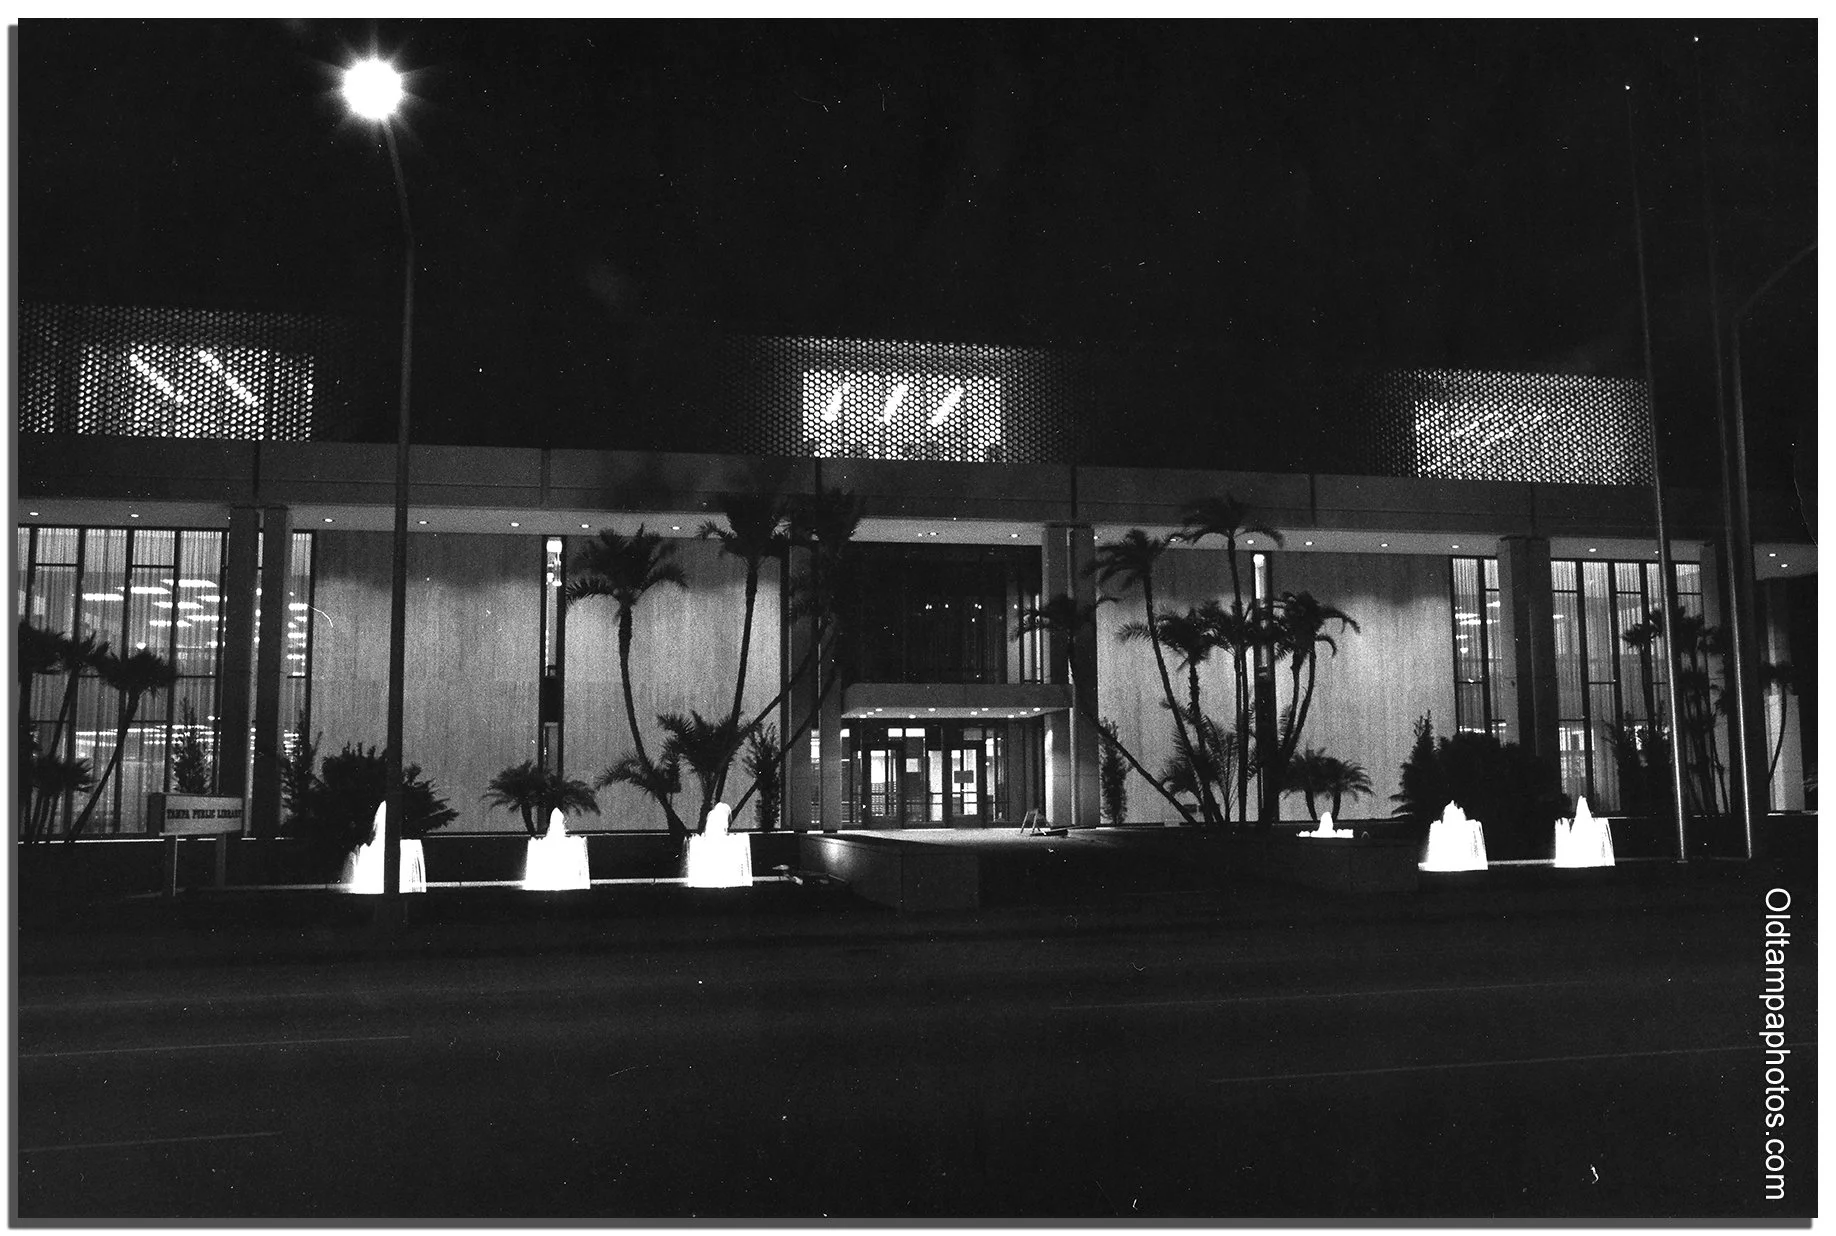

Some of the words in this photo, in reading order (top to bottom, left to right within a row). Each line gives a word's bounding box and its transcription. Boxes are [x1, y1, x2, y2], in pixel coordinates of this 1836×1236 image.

[166, 809, 190, 819] TAMPA
[192, 809, 216, 819] PUBLIC
[217, 809, 243, 819] LIBRARY
